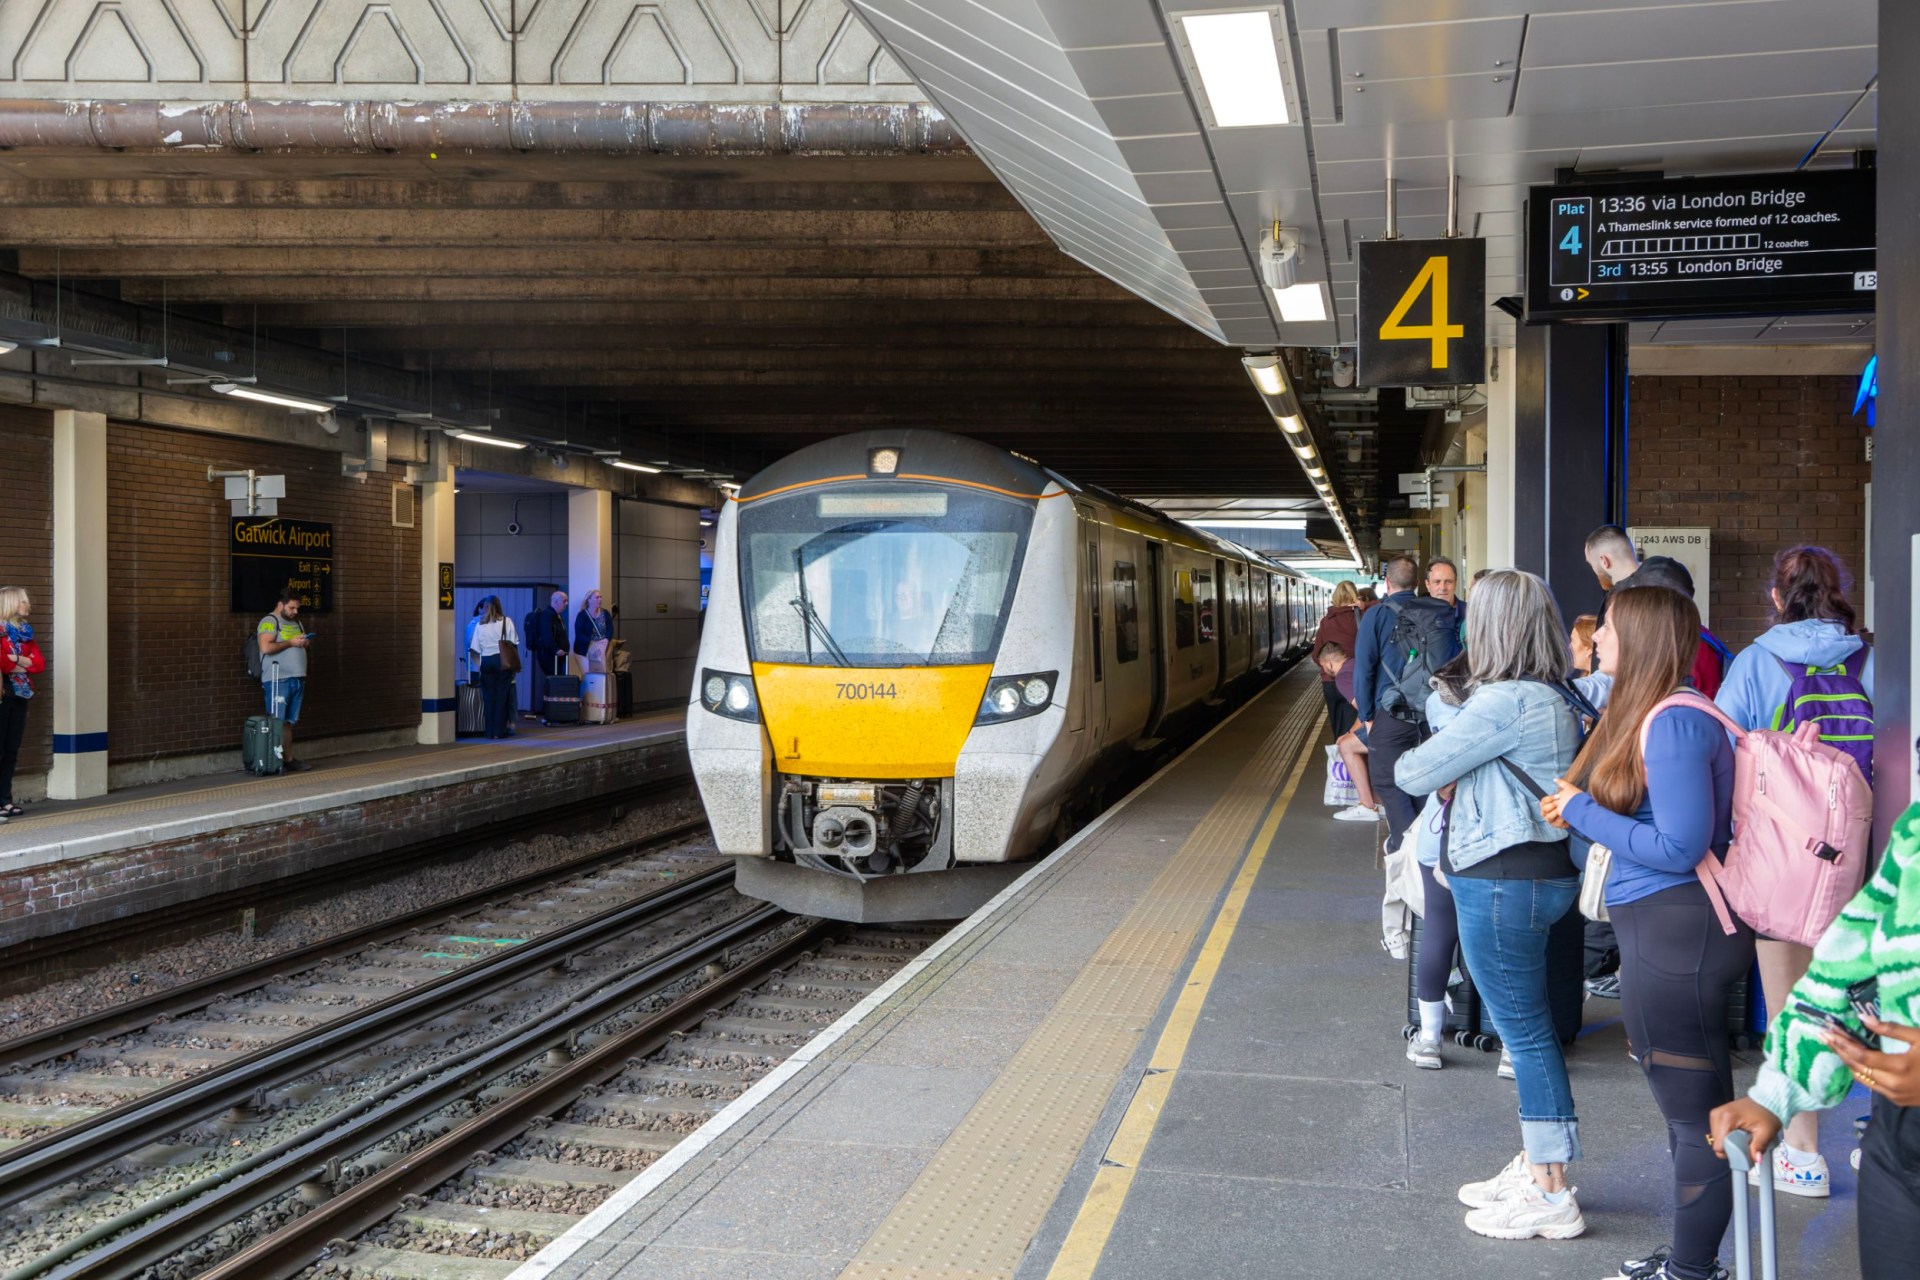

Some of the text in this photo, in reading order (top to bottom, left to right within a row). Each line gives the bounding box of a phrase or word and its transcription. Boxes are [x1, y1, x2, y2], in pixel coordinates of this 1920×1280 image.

[1558, 203, 1585, 216] Plat
[1599, 189, 1806, 213] 13:36 via London Bridge
[1597, 211, 1841, 233] A Thameslink service formed of 12 coaches.
[1558, 225, 1583, 256] 4
[1763, 240, 1810, 249] 12 coaches
[1597, 256, 1783, 277] 3rd 13:55 London Bridge
[1379, 255, 1464, 369] 4
[234, 521, 331, 551] Gatwick Airport
[1643, 535, 1702, 544] 243 AWS DB
[299, 561, 311, 573] Exit
[288, 578, 311, 592] Airport
[835, 682, 898, 700] 700144
